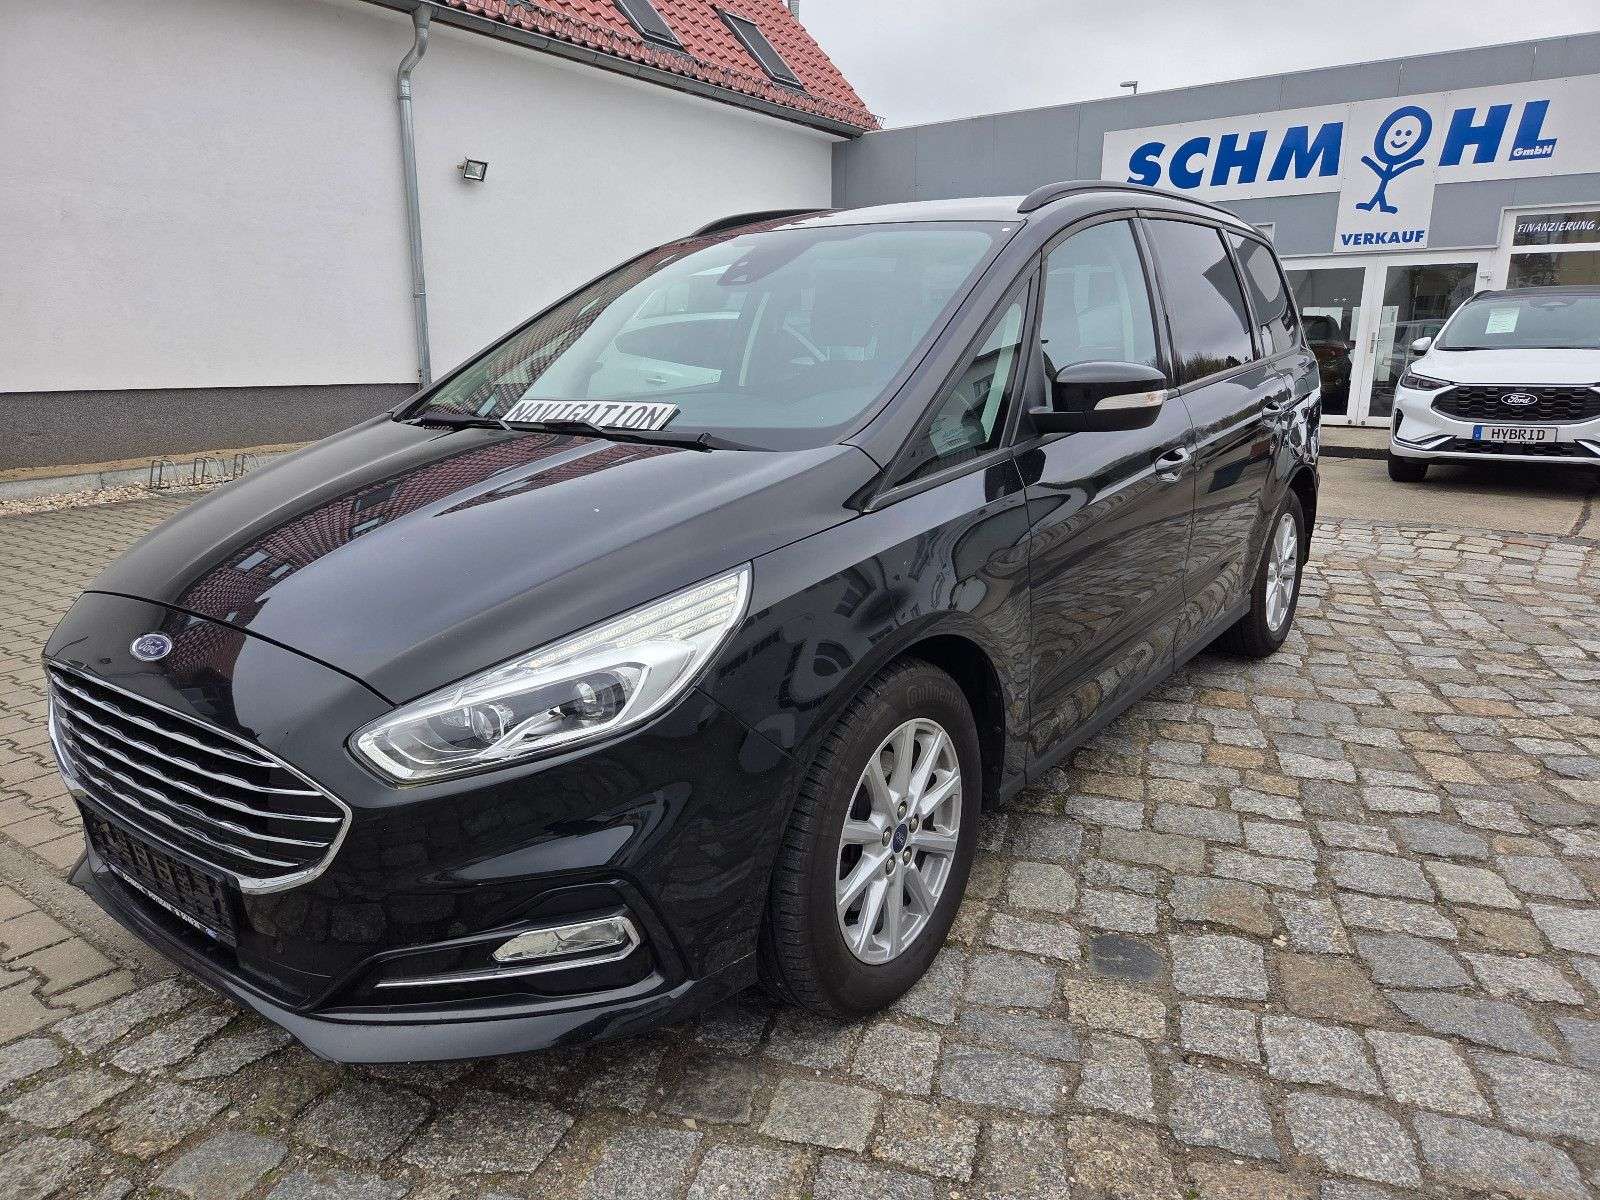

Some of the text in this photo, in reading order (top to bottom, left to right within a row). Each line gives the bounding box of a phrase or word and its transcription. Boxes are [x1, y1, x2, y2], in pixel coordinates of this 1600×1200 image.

[1513, 145, 1553, 157] GmbH
[1517, 220, 1596, 233] FINANZIERUNG
[1341, 230, 1425, 246] VERKAUF
[1505, 394, 1533, 404] Ford
[507, 402, 667, 430] NAVIGATION
[1491, 428, 1546, 441] HYBRID
